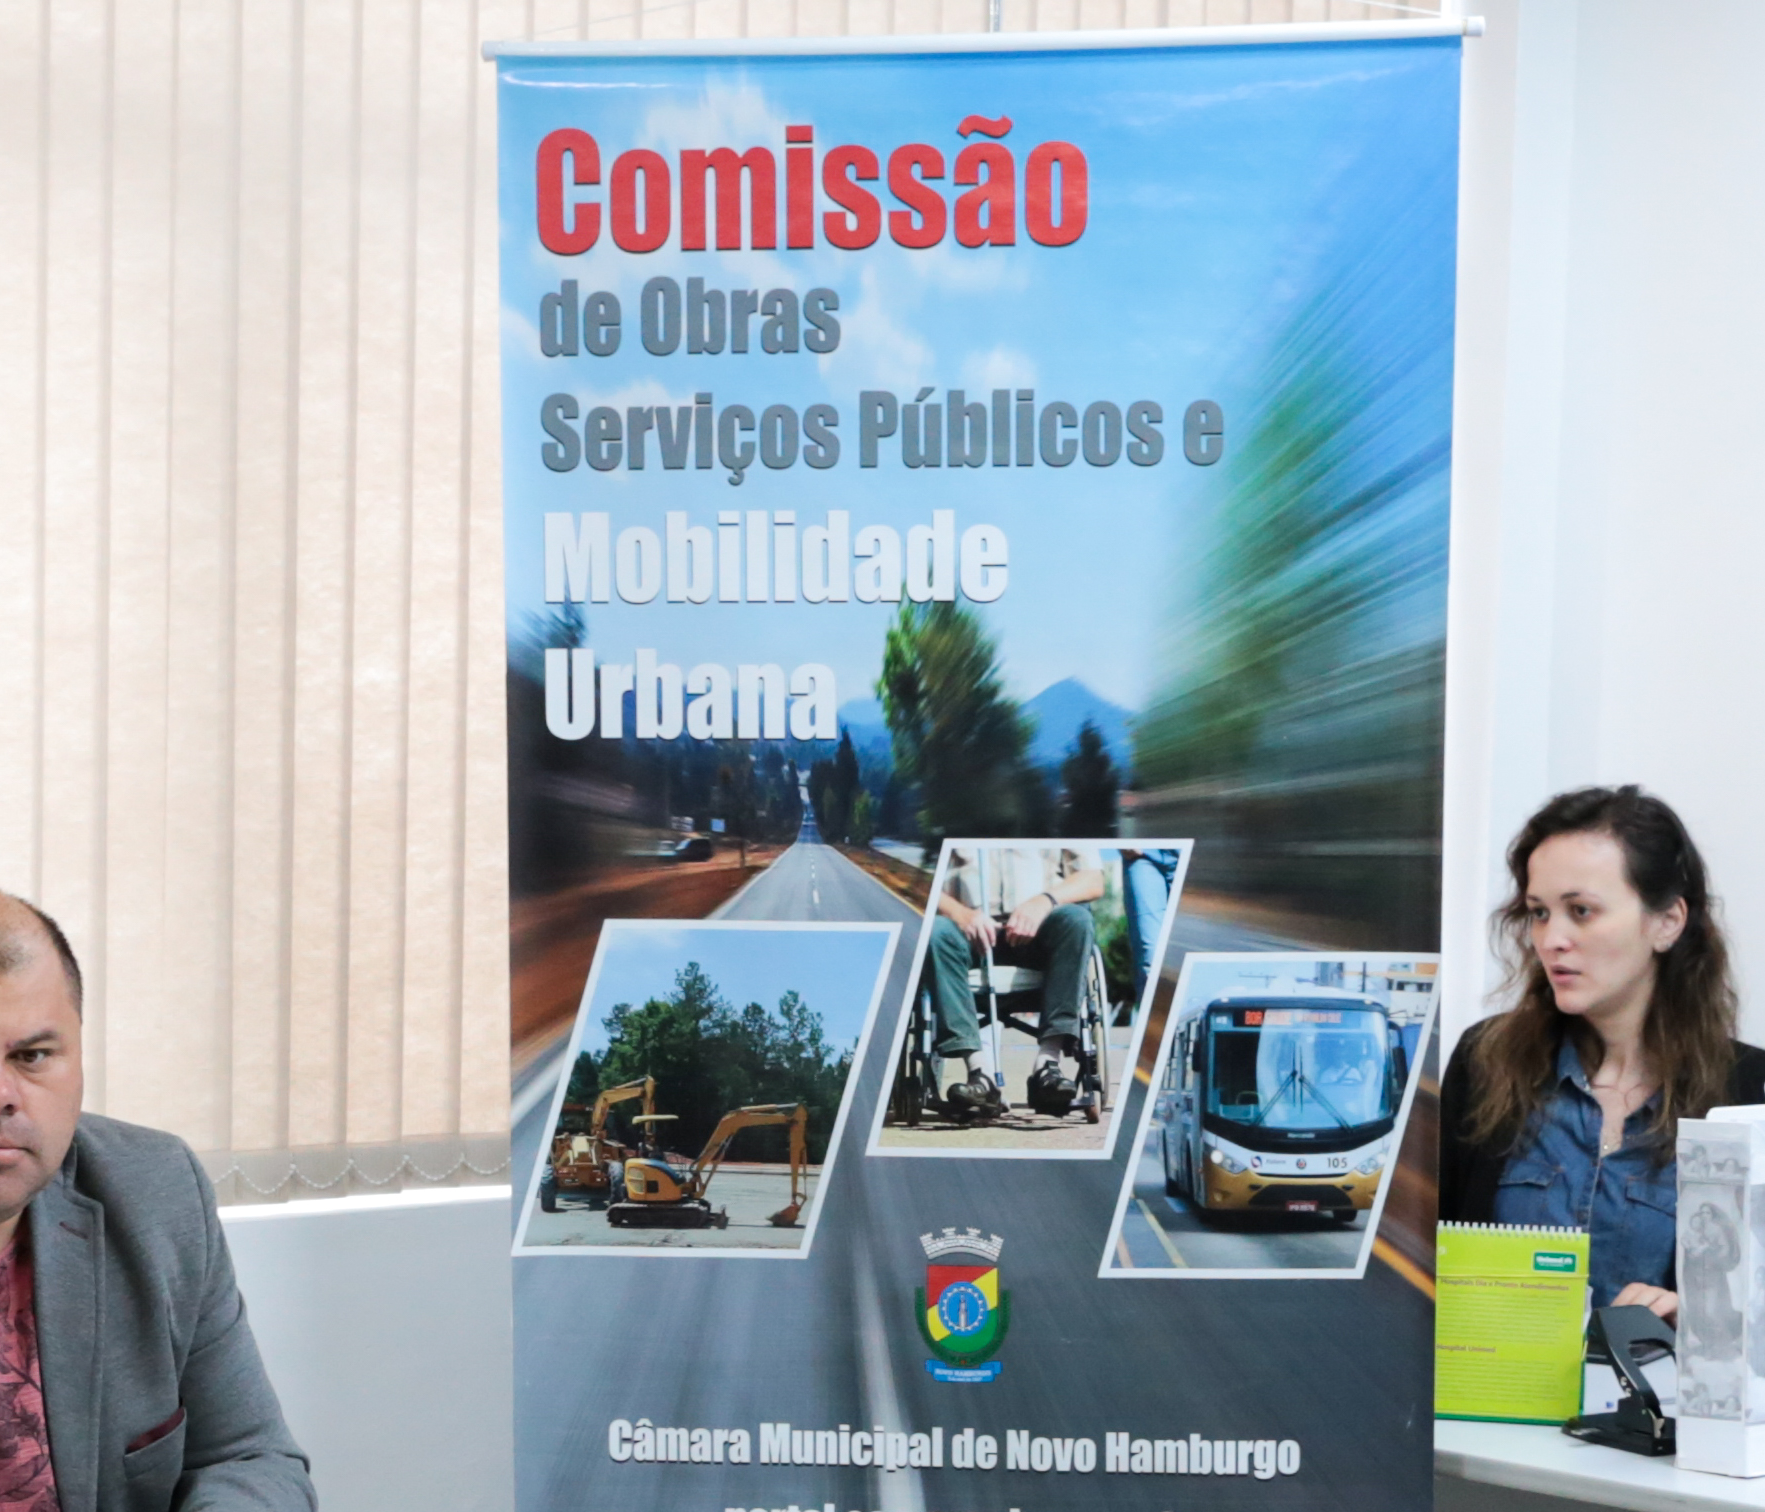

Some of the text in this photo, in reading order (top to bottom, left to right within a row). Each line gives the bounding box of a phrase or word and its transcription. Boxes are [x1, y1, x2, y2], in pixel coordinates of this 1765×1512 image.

[535, 115, 1089, 256] Comissão
[539, 276, 841, 357] de Obras
[540, 386, 1225, 486] Serviços Públicos e
[543, 509, 1010, 605] Mobilidade
[544, 648, 838, 740] Urbana
[1327, 1157, 1347, 1168] 105
[608, 1419, 1301, 1480] Câmara Municipal de Novo Hamburgo
